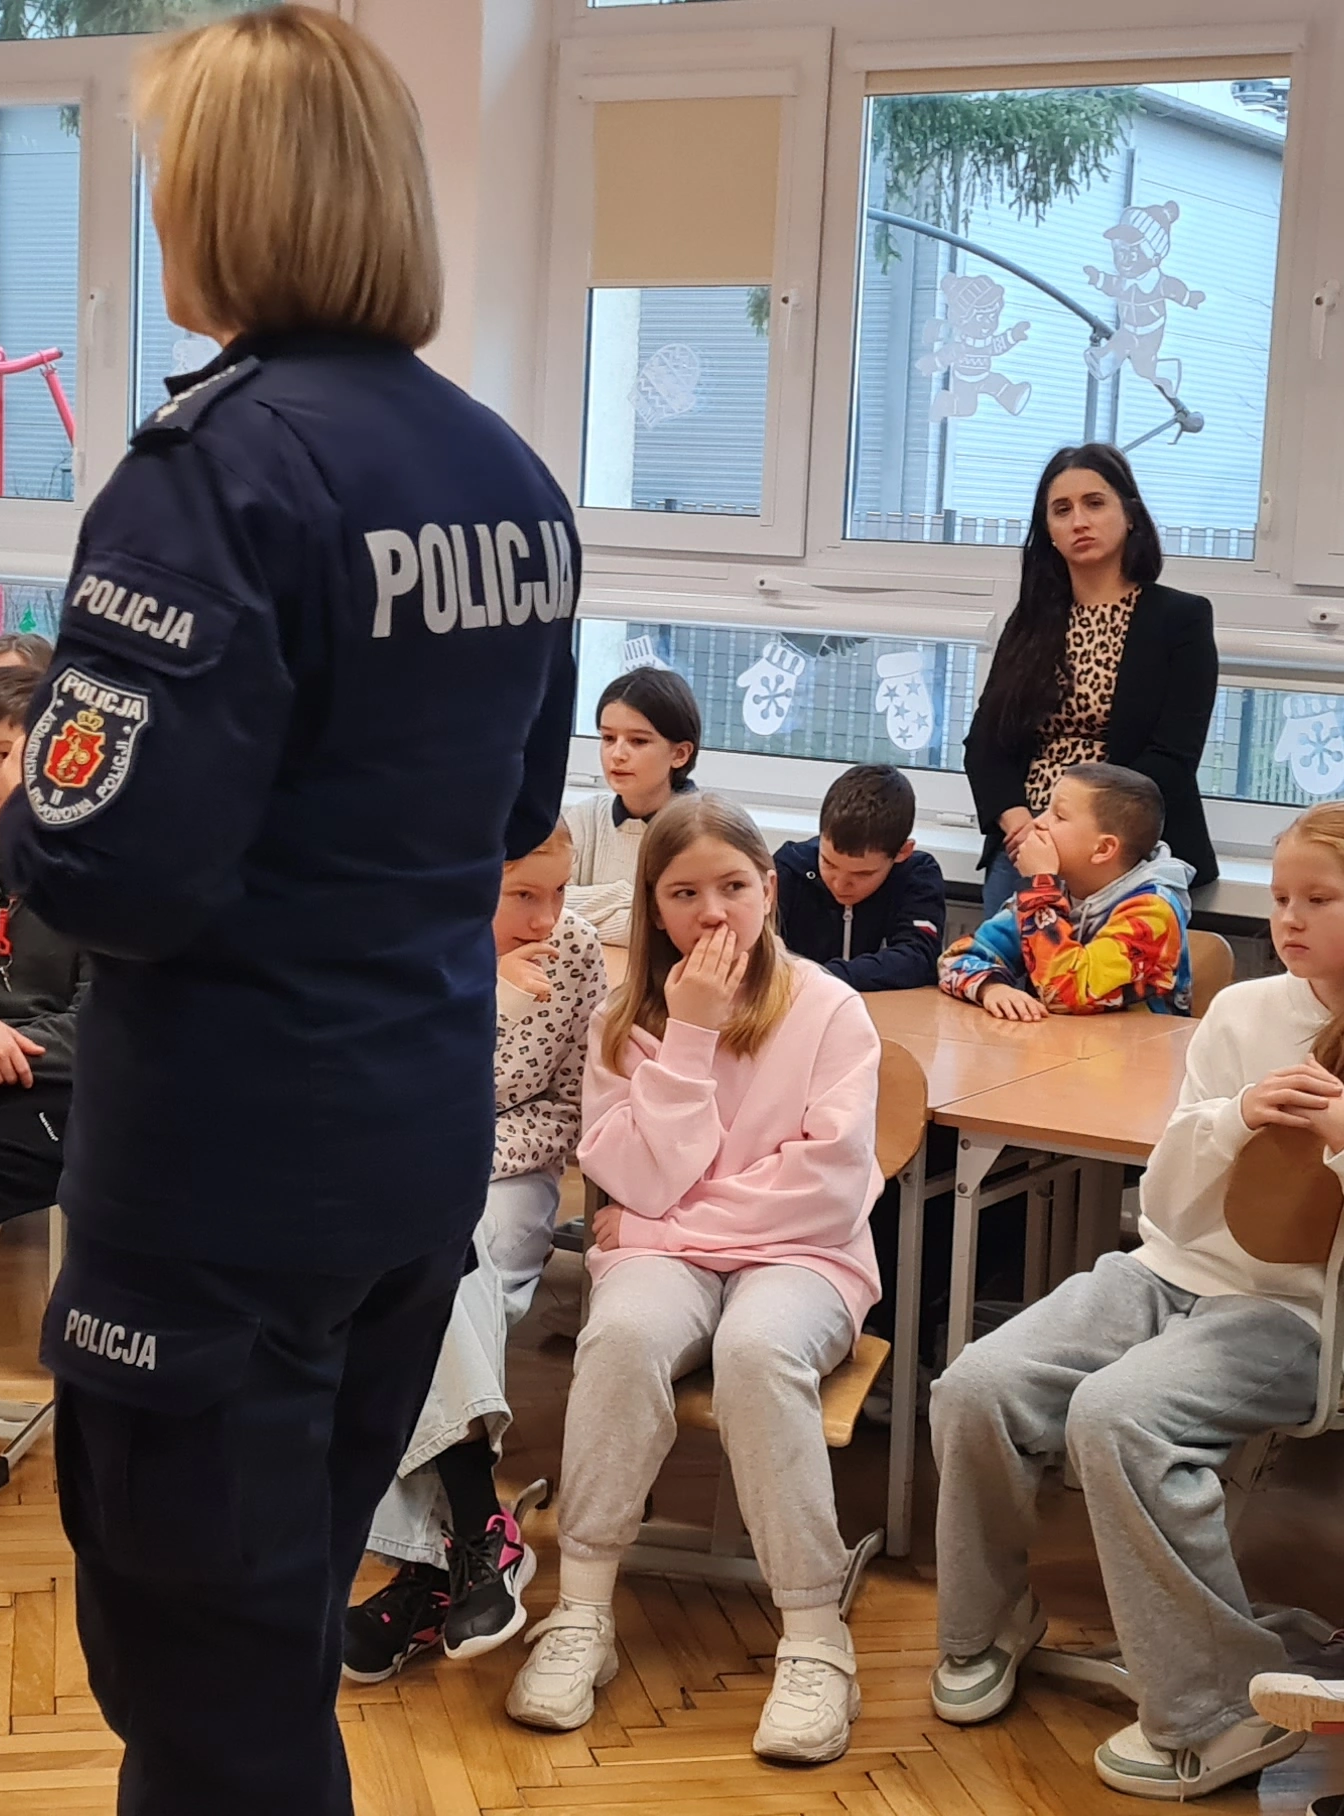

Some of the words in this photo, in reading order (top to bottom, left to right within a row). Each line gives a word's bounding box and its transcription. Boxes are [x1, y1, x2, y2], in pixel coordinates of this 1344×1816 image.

[364, 520, 574, 638] POLICJA
[72, 575, 195, 650] POLICJA
[62, 675, 143, 721] POLICJA
[95, 740, 130, 799] POLICJI
[63, 1308, 158, 1371] POLICJA
